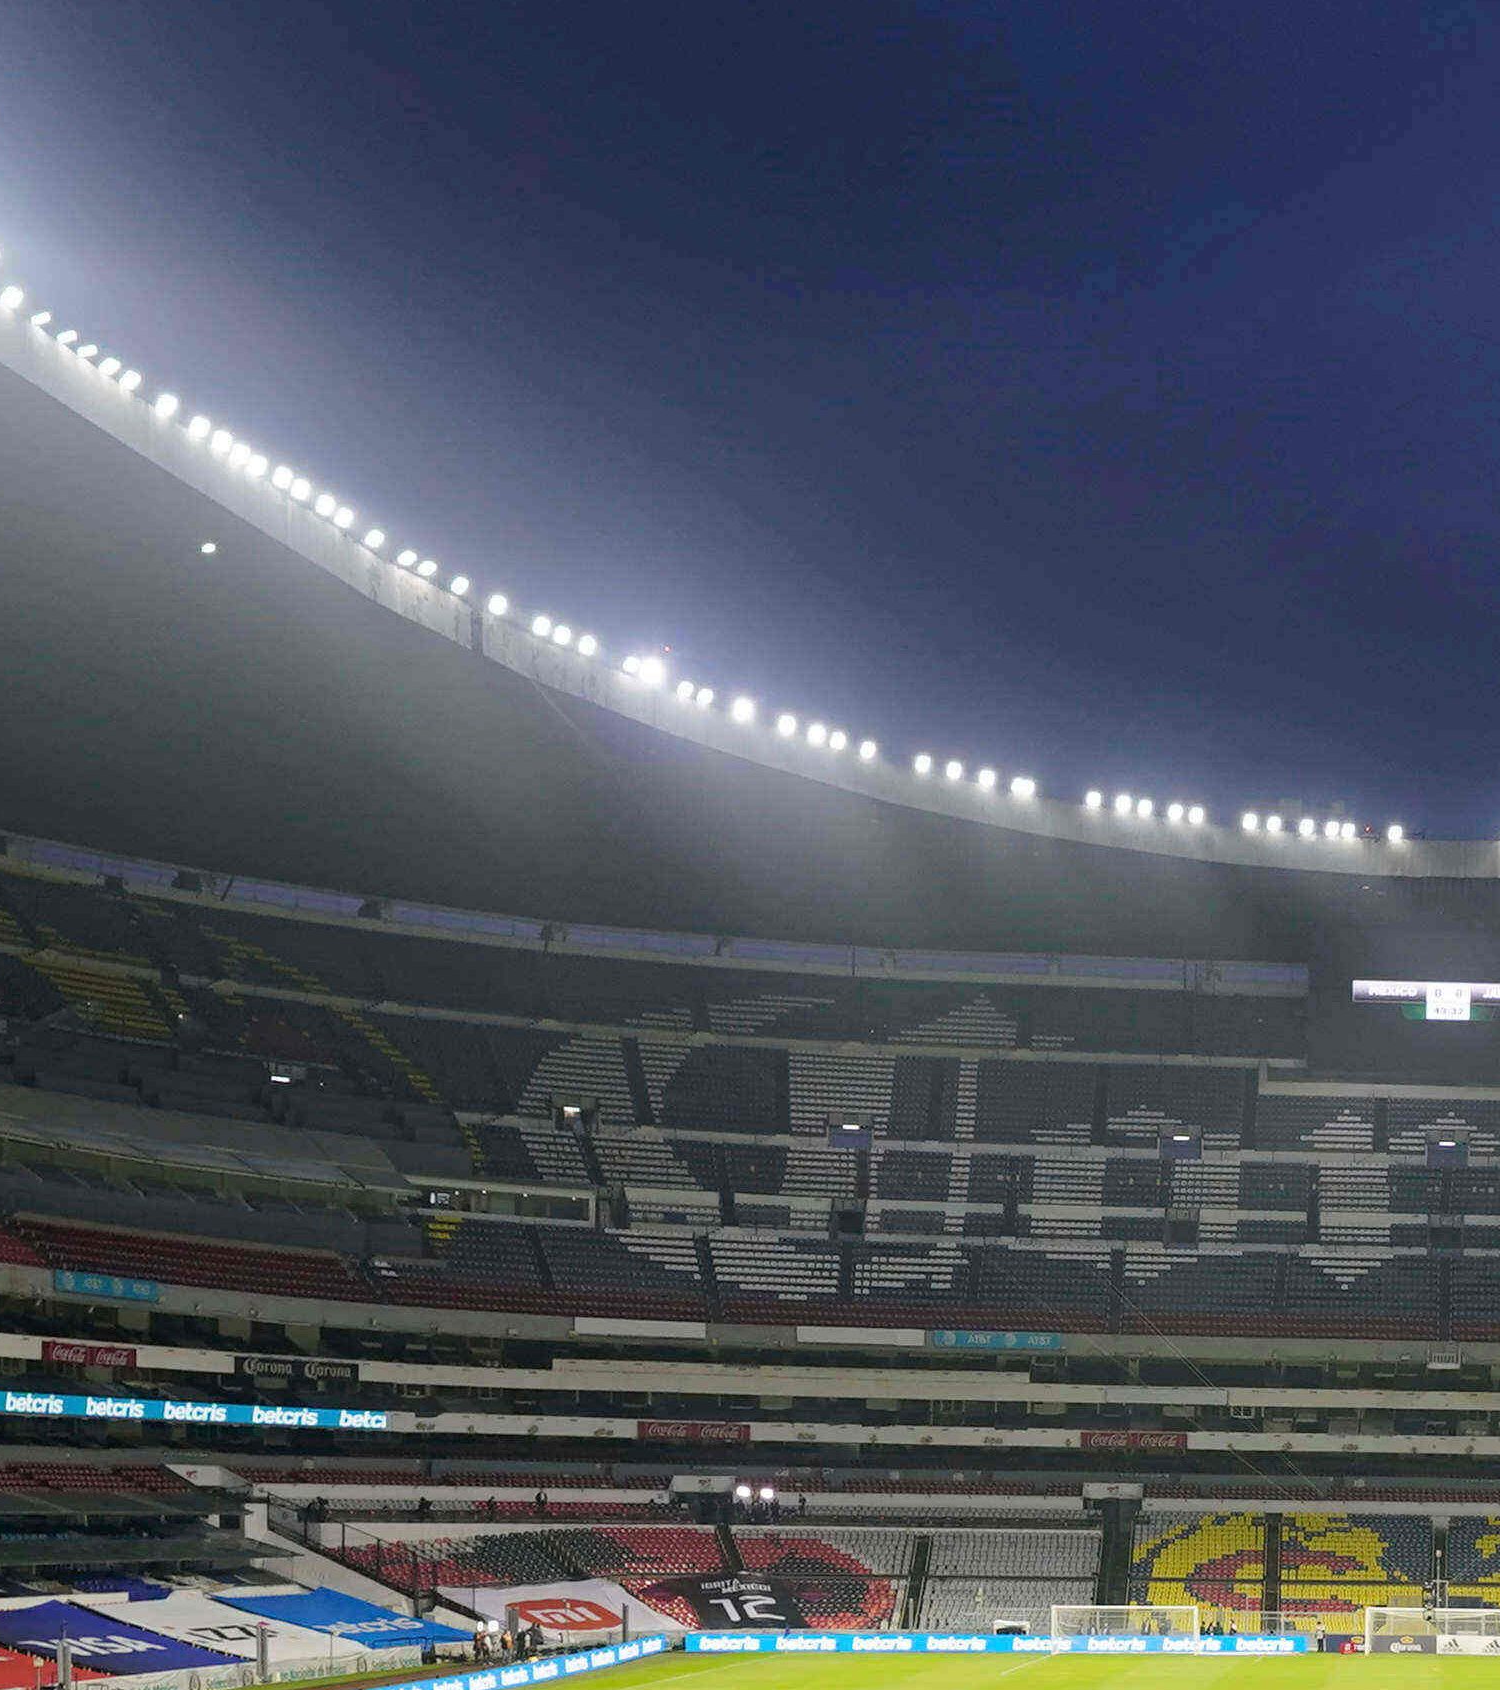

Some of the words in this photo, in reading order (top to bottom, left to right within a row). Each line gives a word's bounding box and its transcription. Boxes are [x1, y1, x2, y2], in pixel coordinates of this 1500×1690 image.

[243, 1358, 292, 1377] Corona
[304, 1361, 352, 1380] Corona
[5, 1391, 65, 1415] betcris
[85, 1396, 144, 1420] betcris
[163, 1400, 228, 1422] betcris
[252, 1405, 319, 1427] betcris
[340, 1408, 387, 1429] betc
[708, 1595, 787, 1622] 12
[17, 1635, 168, 1657] VISA
